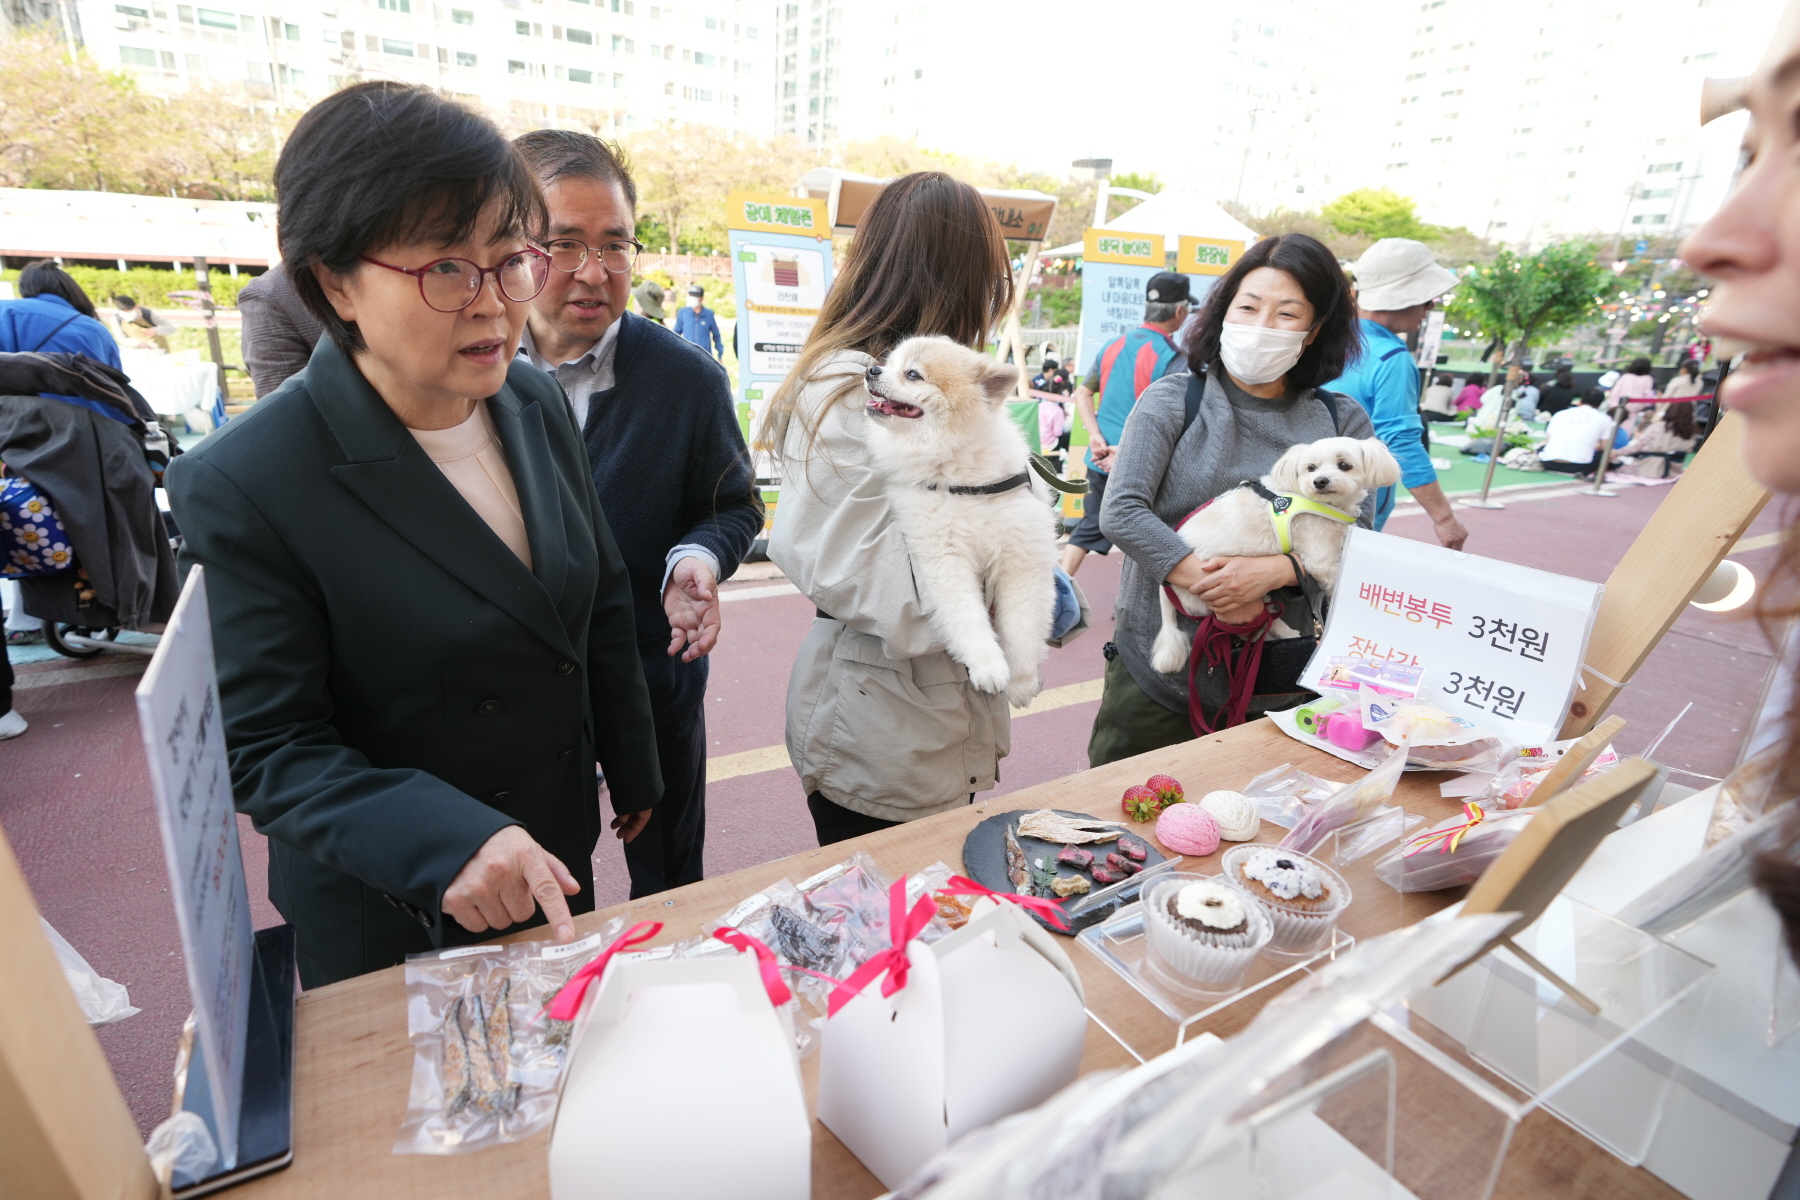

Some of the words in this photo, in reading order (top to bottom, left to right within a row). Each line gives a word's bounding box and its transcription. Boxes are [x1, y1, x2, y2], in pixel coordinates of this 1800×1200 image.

[744, 202, 772, 223] 공예
[774, 206, 813, 228] 체험존
[1098, 237, 1121, 254] 바닥
[1196, 245, 1230, 266] 화장실
[1107, 275, 1141, 290] 알록달록
[1102, 291, 1112, 304] 내
[1112, 292, 1145, 307] 마음대로
[1106, 307, 1140, 321] 색칠하는
[1358, 581, 1454, 630] 배변봉투
[1466, 614, 1551, 663] 3천원
[1386, 663, 1405, 672] DOG
[1405, 667, 1422, 676] TOY
[1441, 670, 1527, 722] 3천원
